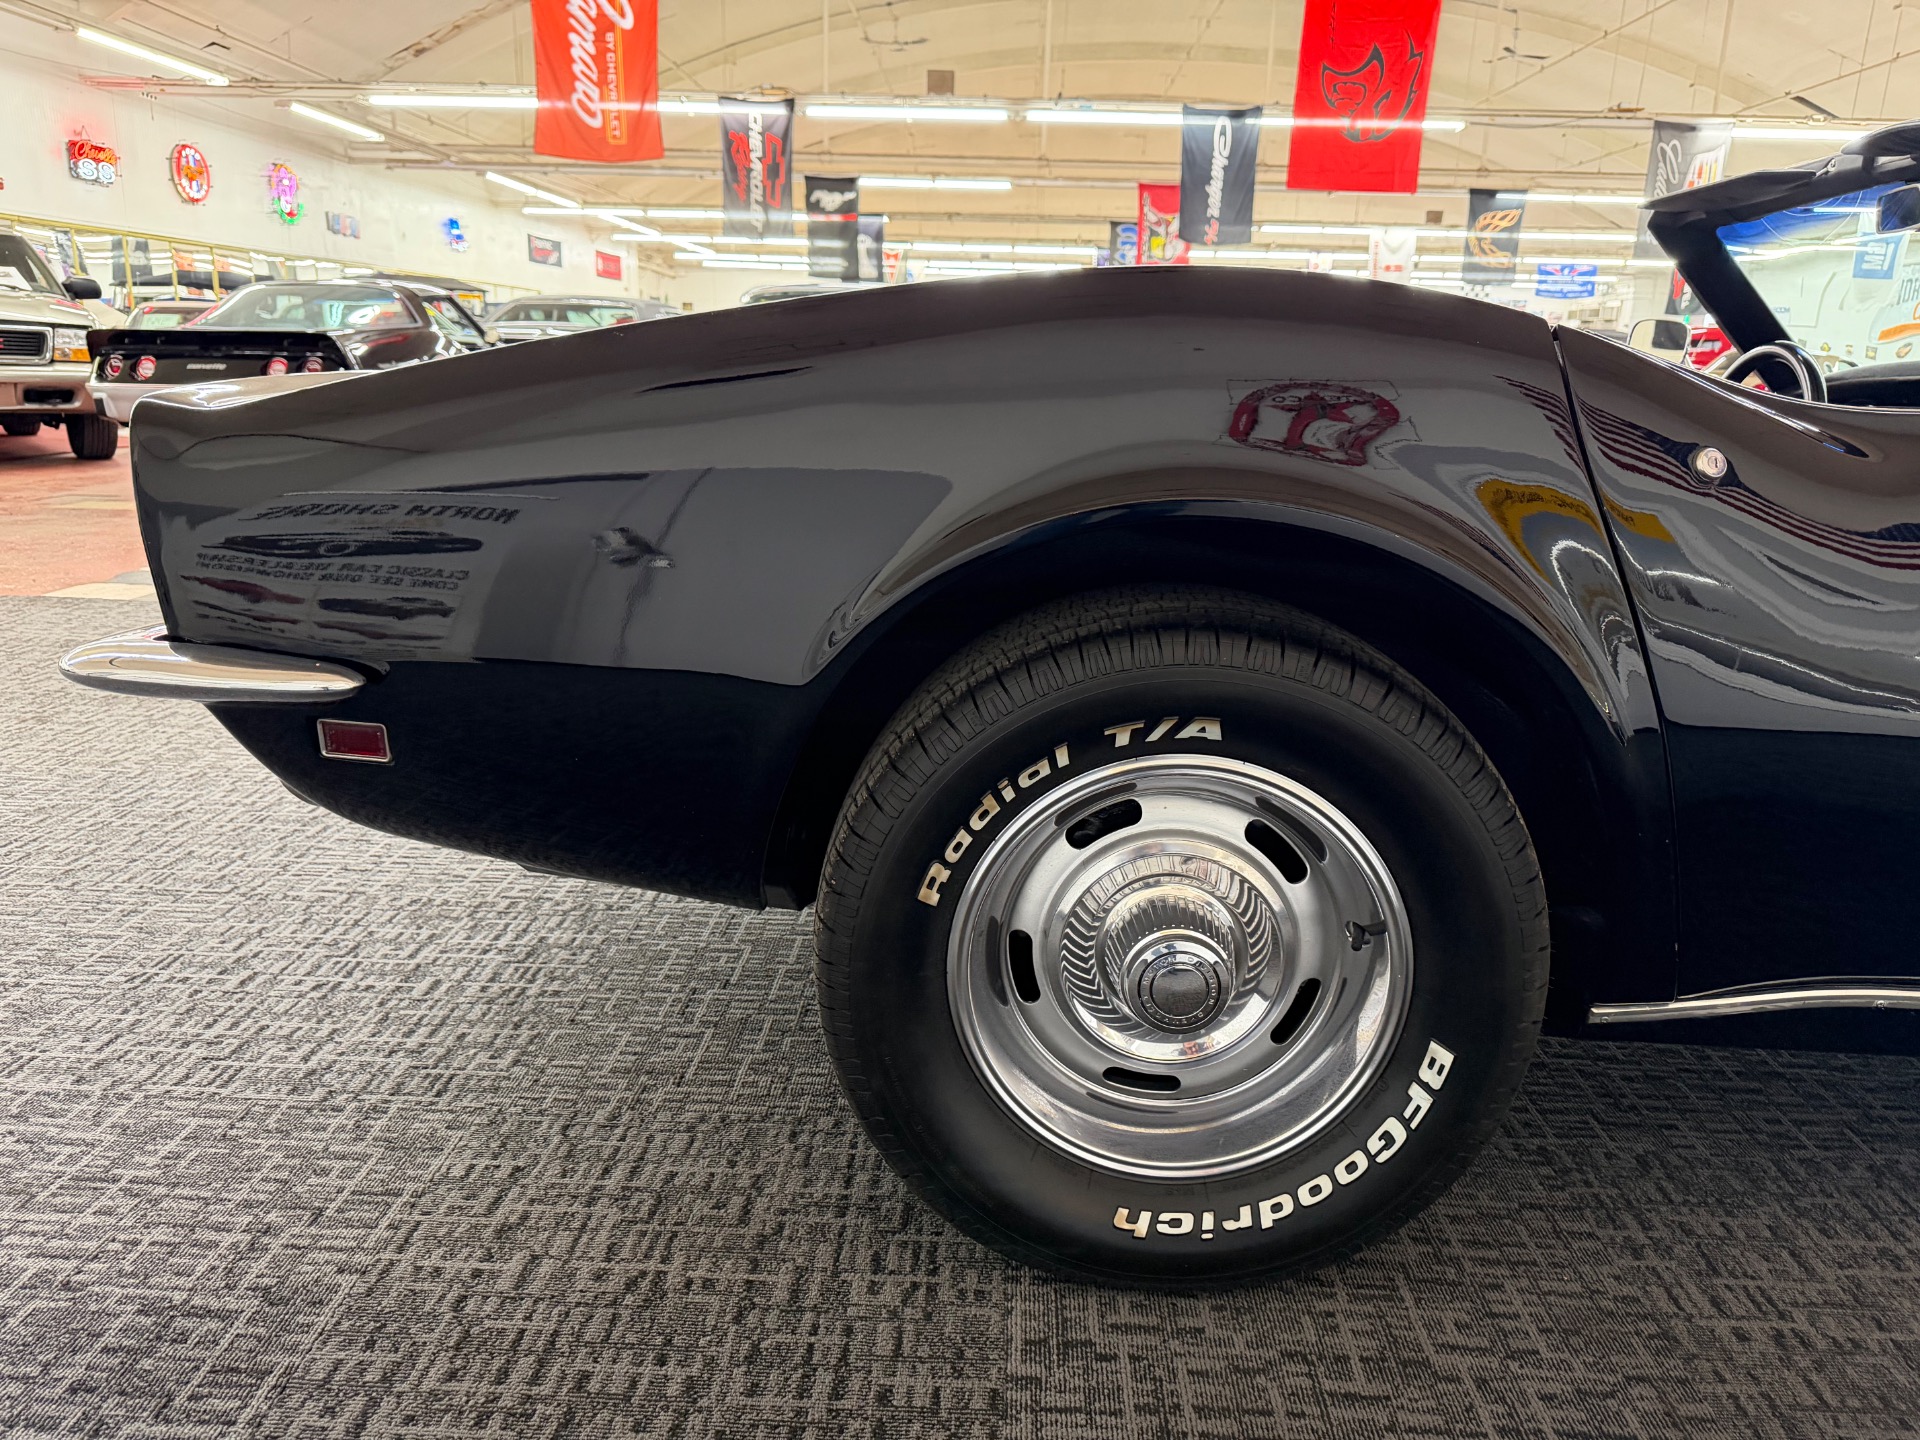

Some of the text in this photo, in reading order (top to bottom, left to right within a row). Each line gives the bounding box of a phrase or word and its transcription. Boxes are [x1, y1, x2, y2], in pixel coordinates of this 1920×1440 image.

[605, 31, 616, 50] BY
[78, 158, 116, 183] SS
[749, 113, 765, 233] CHEVROLET
[1205, 116, 1232, 218] Charger
[917, 716, 1222, 907] Radial T/A
[1113, 1039, 1456, 1240] BFGoodrich
